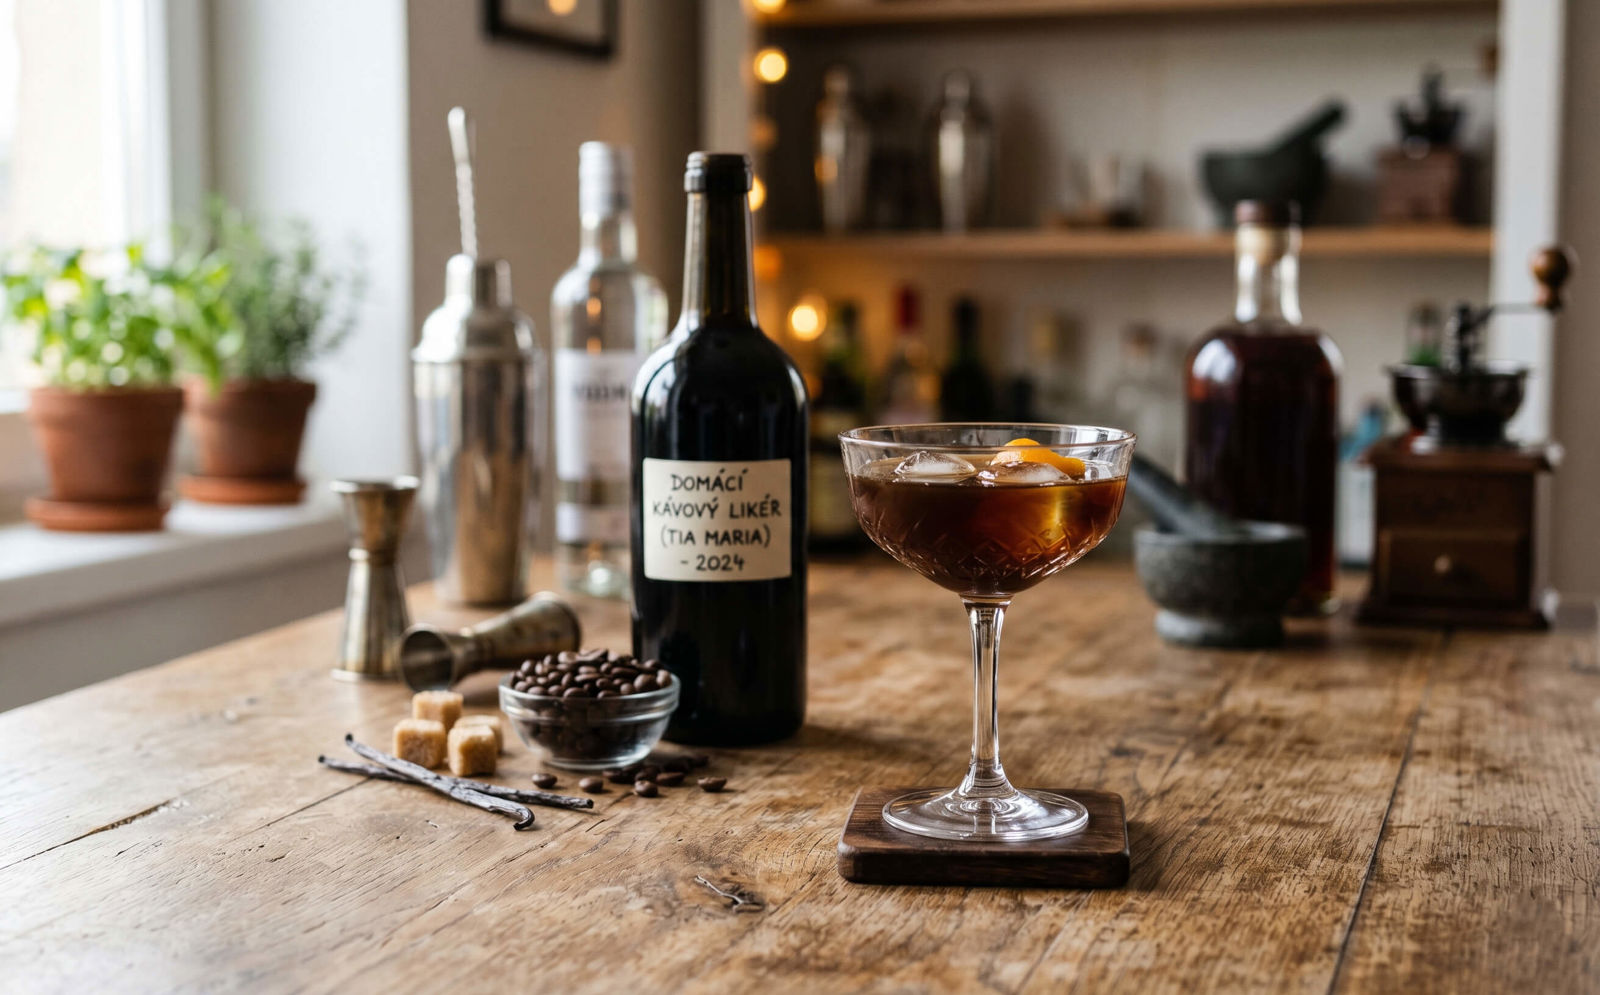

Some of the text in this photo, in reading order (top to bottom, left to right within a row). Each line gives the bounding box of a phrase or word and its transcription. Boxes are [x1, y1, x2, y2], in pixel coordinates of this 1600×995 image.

[671, 468, 749, 491] DOMÁCÍ
[652, 493, 782, 518] KÁVOVÝ LIKÉR
[661, 523, 771, 548] (TIA MARIA)
[695, 553, 745, 571] 2024
